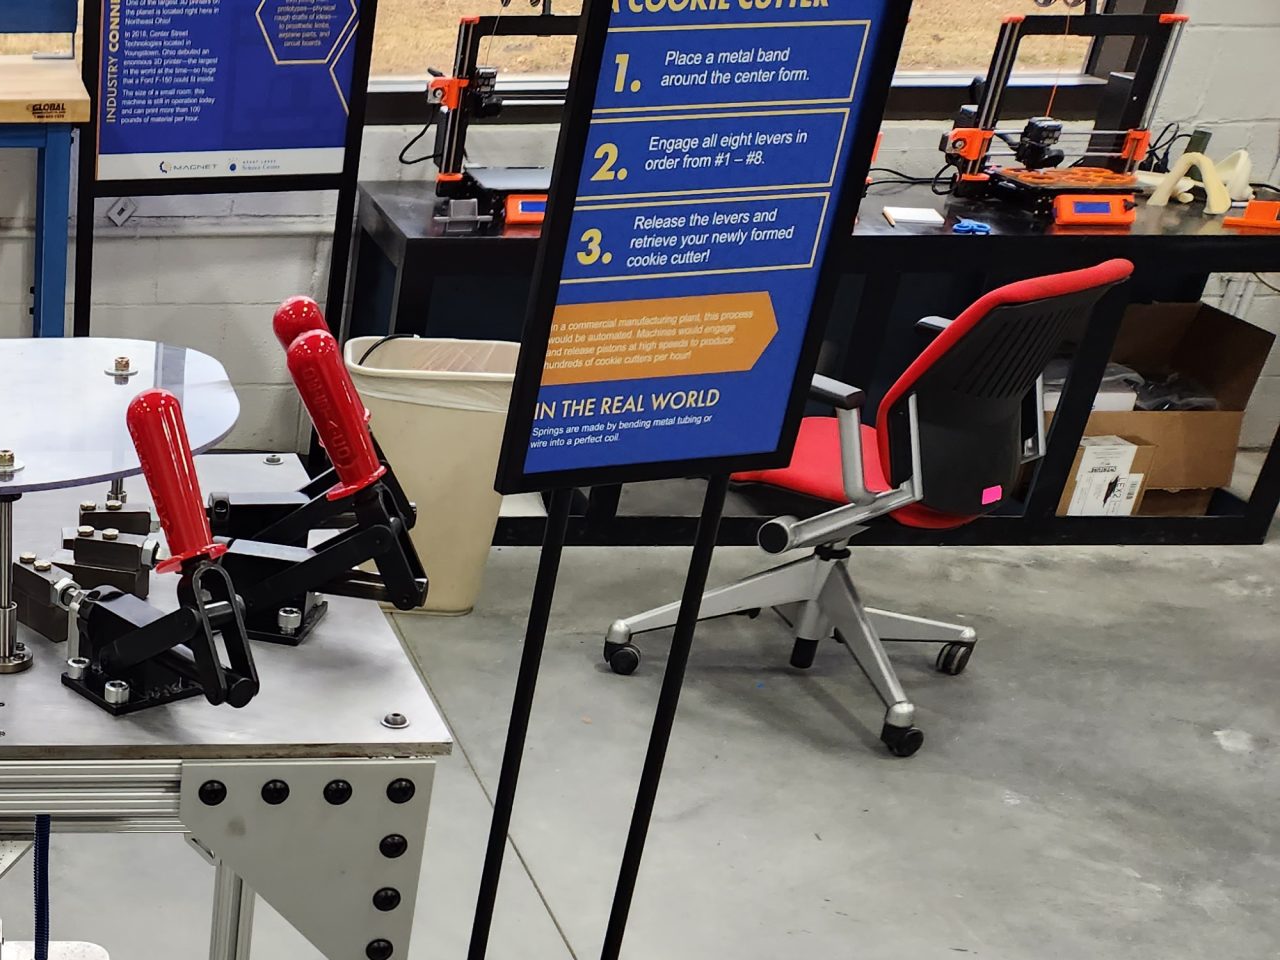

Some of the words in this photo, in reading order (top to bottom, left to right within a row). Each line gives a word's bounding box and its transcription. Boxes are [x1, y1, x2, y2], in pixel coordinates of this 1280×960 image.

[665, 50, 702, 66] Place
[705, 54, 714, 64] a
[718, 49, 753, 63] metal
[757, 47, 790, 62] band
[614, 53, 642, 92] 1.
[661, 70, 708, 86] around
[711, 70, 731, 84] the
[734, 69, 775, 83] center
[778, 68, 810, 81] form.
[106, 56, 118, 122] INDUSTRY
[32, 103, 66, 111] GLOBAL
[649, 136, 699, 153] Engage
[702, 134, 717, 148] all
[720, 133, 752, 150] eight
[754, 132, 792, 145] levers
[796, 129, 807, 143] in
[590, 143, 628, 181] 2.
[645, 155, 680, 171] order
[682, 154, 711, 169] from
[714, 153, 731, 166] #1
[745, 151, 765, 165] #8.
[634, 215, 686, 230] Release
[689, 214, 709, 227] the
[712, 211, 749, 225] levers
[752, 209, 778, 223] and
[576, 228, 613, 265] 3.
[630, 234, 678, 249] retrieve
[680, 234, 710, 248] your
[712, 230, 747, 246] newly
[750, 226, 794, 241] formed
[626, 252, 667, 267] cookie
[670, 249, 711, 264] cutter!
[568, 318, 617, 330] commercial
[618, 315, 678, 326] manufacturing
[704, 312, 719, 321] this
[720, 311, 753, 321] process
[549, 334, 572, 344] would
[575, 334, 586, 342] be
[636, 328, 676, 338] Machines
[678, 325, 703, 335] would
[704, 324, 736, 334] engage
[546, 348, 562, 357] and
[564, 346, 594, 355] release
[596, 344, 627, 355] pistons
[628, 343, 636, 351] at
[639, 342, 656, 352] high
[658, 340, 688, 350] speeds
[690, 339, 698, 347] to
[700, 337, 735, 347] produce
[544, 359, 583, 369] hundreds
[585, 358, 594, 366] of
[595, 356, 622, 366] cookie
[624, 355, 652, 364] cutters
[653, 354, 668, 363] per
[534, 402, 556, 420] IN
[562, 398, 596, 418] THE
[600, 395, 644, 415] REAL
[651, 388, 720, 411] WORLD
[532, 426, 564, 438] Springs
[566, 425, 579, 434] are
[581, 423, 604, 433] made
[606, 422, 617, 431] by
[619, 419, 651, 430] bending
[652, 417, 675, 427] metal
[677, 415, 702, 425] tubing
[704, 415, 712, 423] or
[530, 439, 547, 448] wire
[549, 438, 565, 447] into
[566, 438, 572, 446] a
[574, 434, 602, 447] perfect
